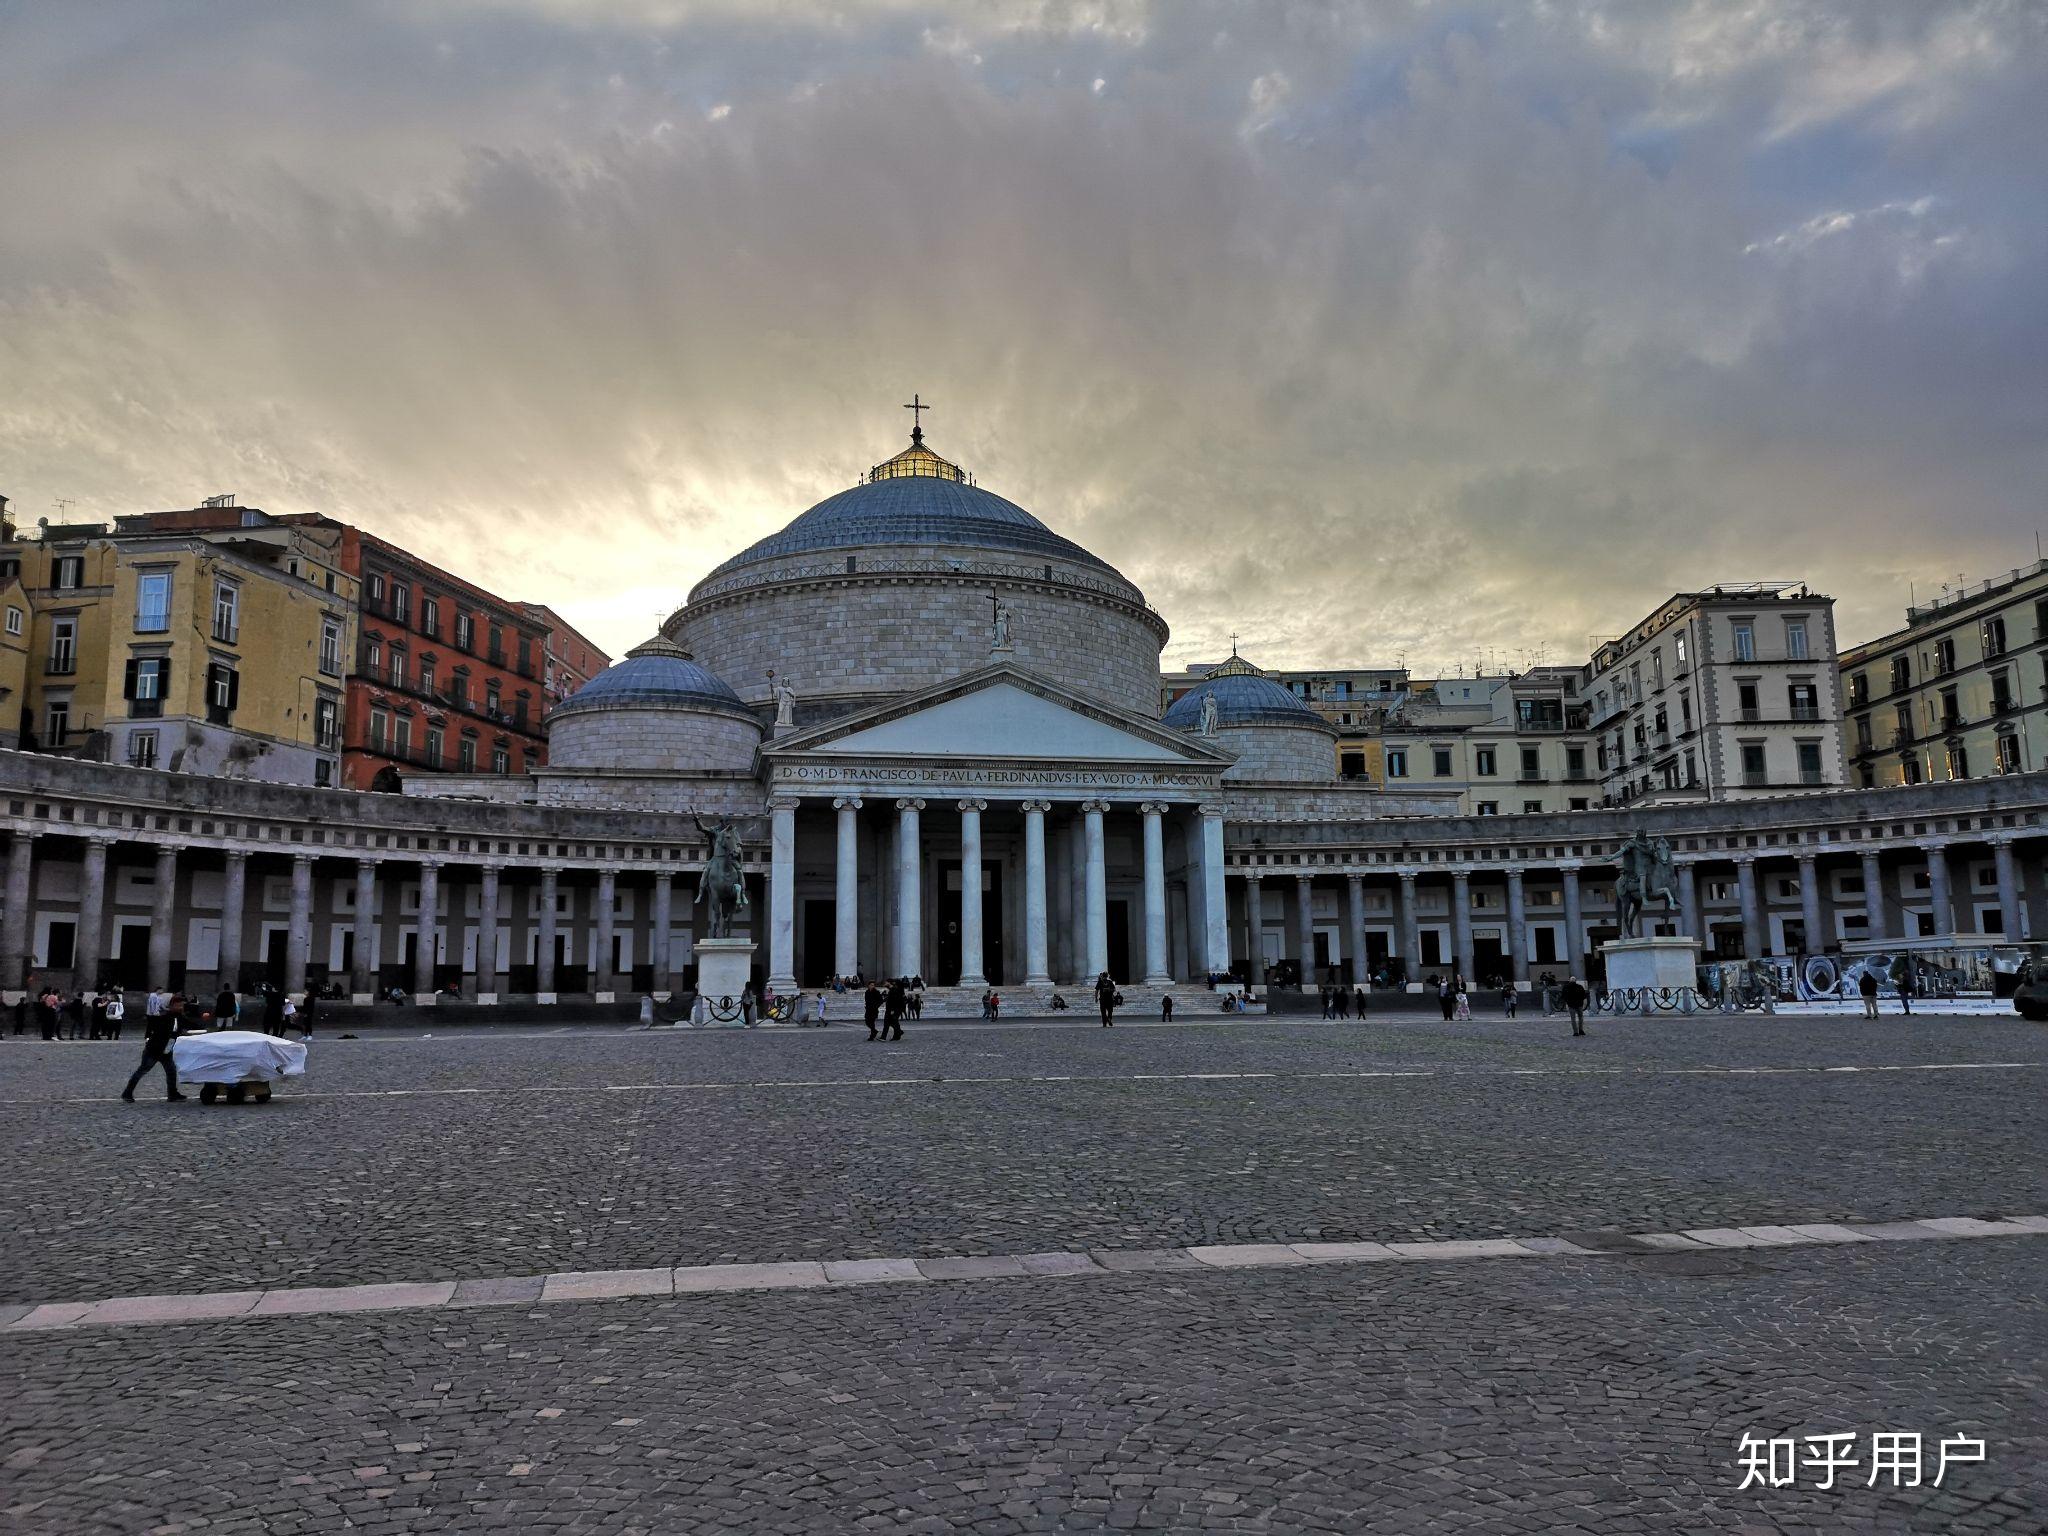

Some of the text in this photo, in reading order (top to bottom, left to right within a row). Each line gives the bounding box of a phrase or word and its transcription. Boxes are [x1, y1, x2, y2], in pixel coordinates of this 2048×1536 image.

[843, 768, 917, 780] FRANCISCO
[922, 770, 938, 781] DE
[943, 770, 983, 782] PAVLA
[987, 771, 1072, 783] FERDINANDVS
[1083, 773, 1098, 784] EX
[1102, 773, 1136, 784] VOTO
[1152, 775, 1213, 786] MDCCCXVI
